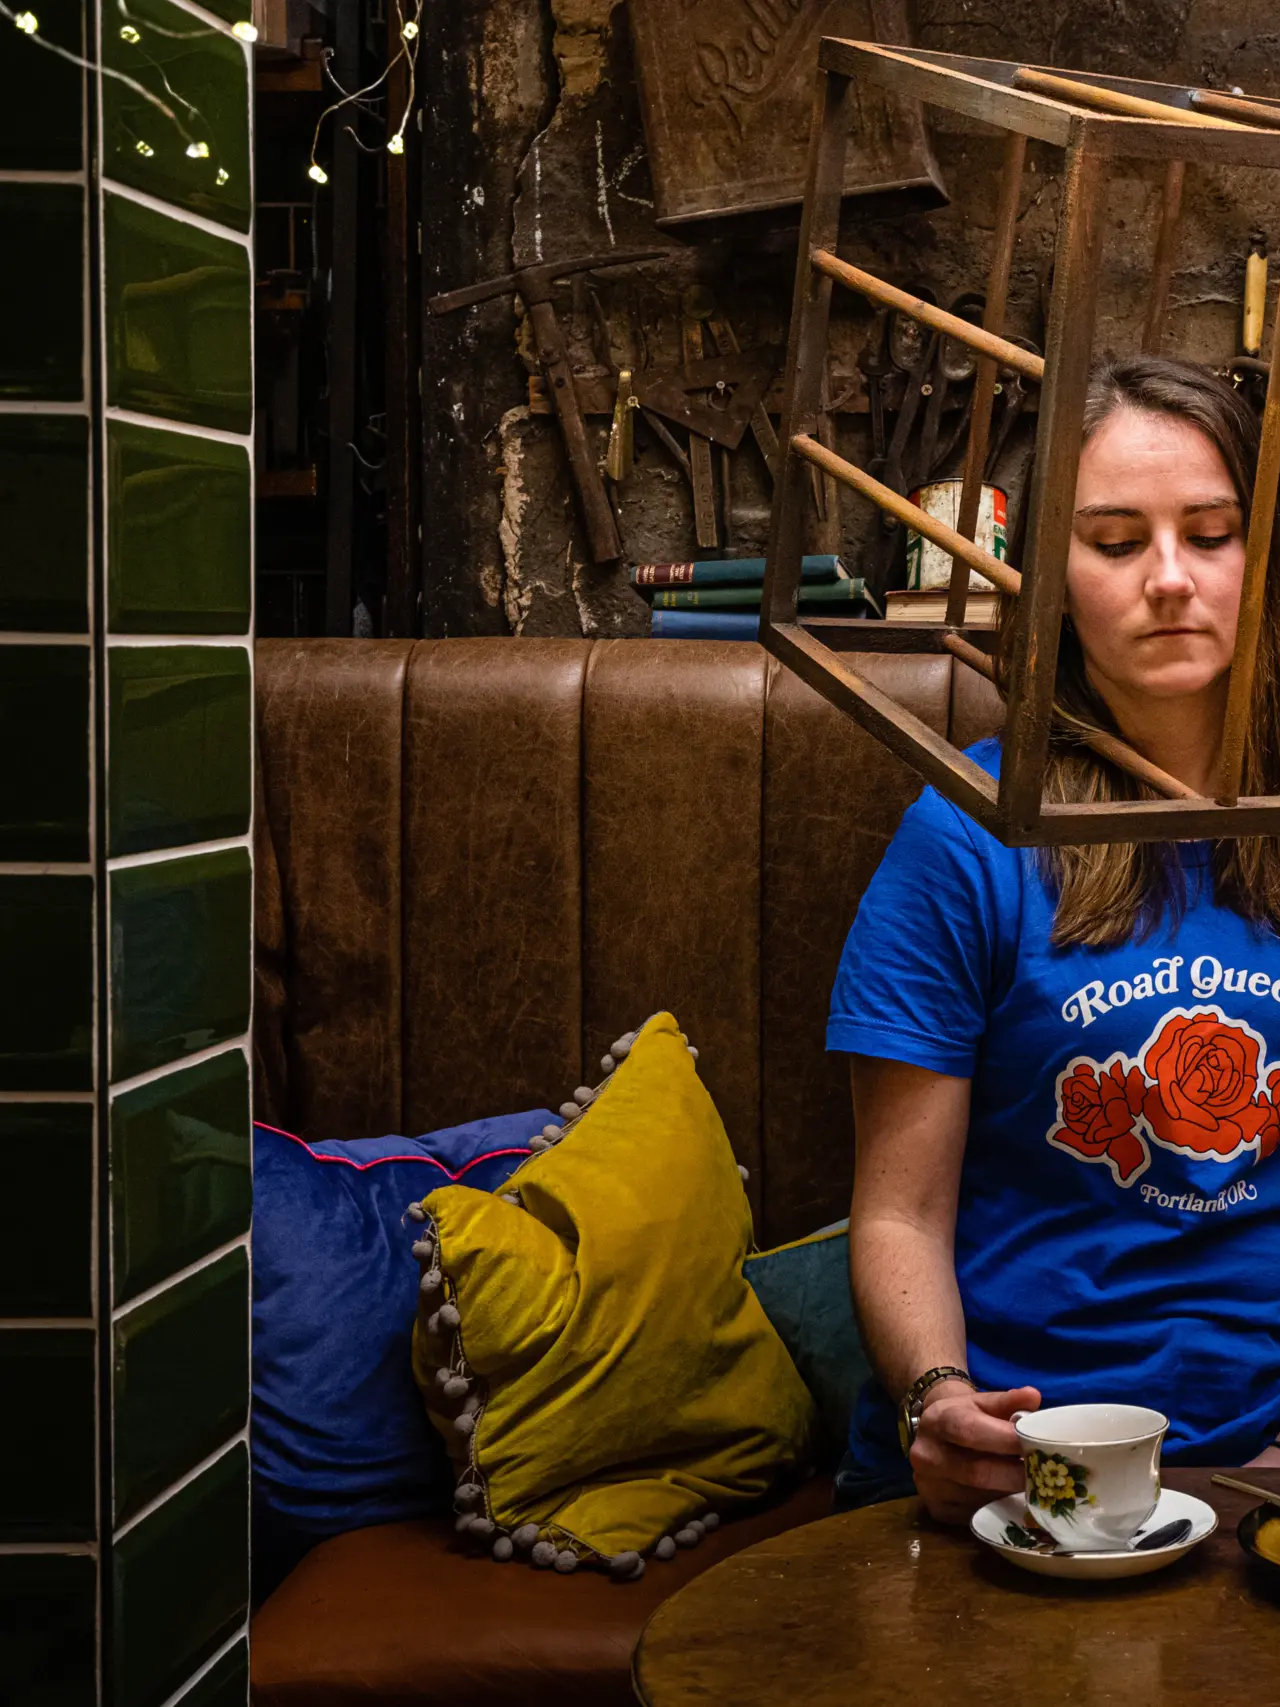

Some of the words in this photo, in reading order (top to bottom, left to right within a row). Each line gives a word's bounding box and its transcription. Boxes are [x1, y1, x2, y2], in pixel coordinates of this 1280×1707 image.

[1061, 956, 1184, 1028] Road
[1140, 1183, 1228, 1213] Portland,
[1227, 1180, 1258, 1205] OR
